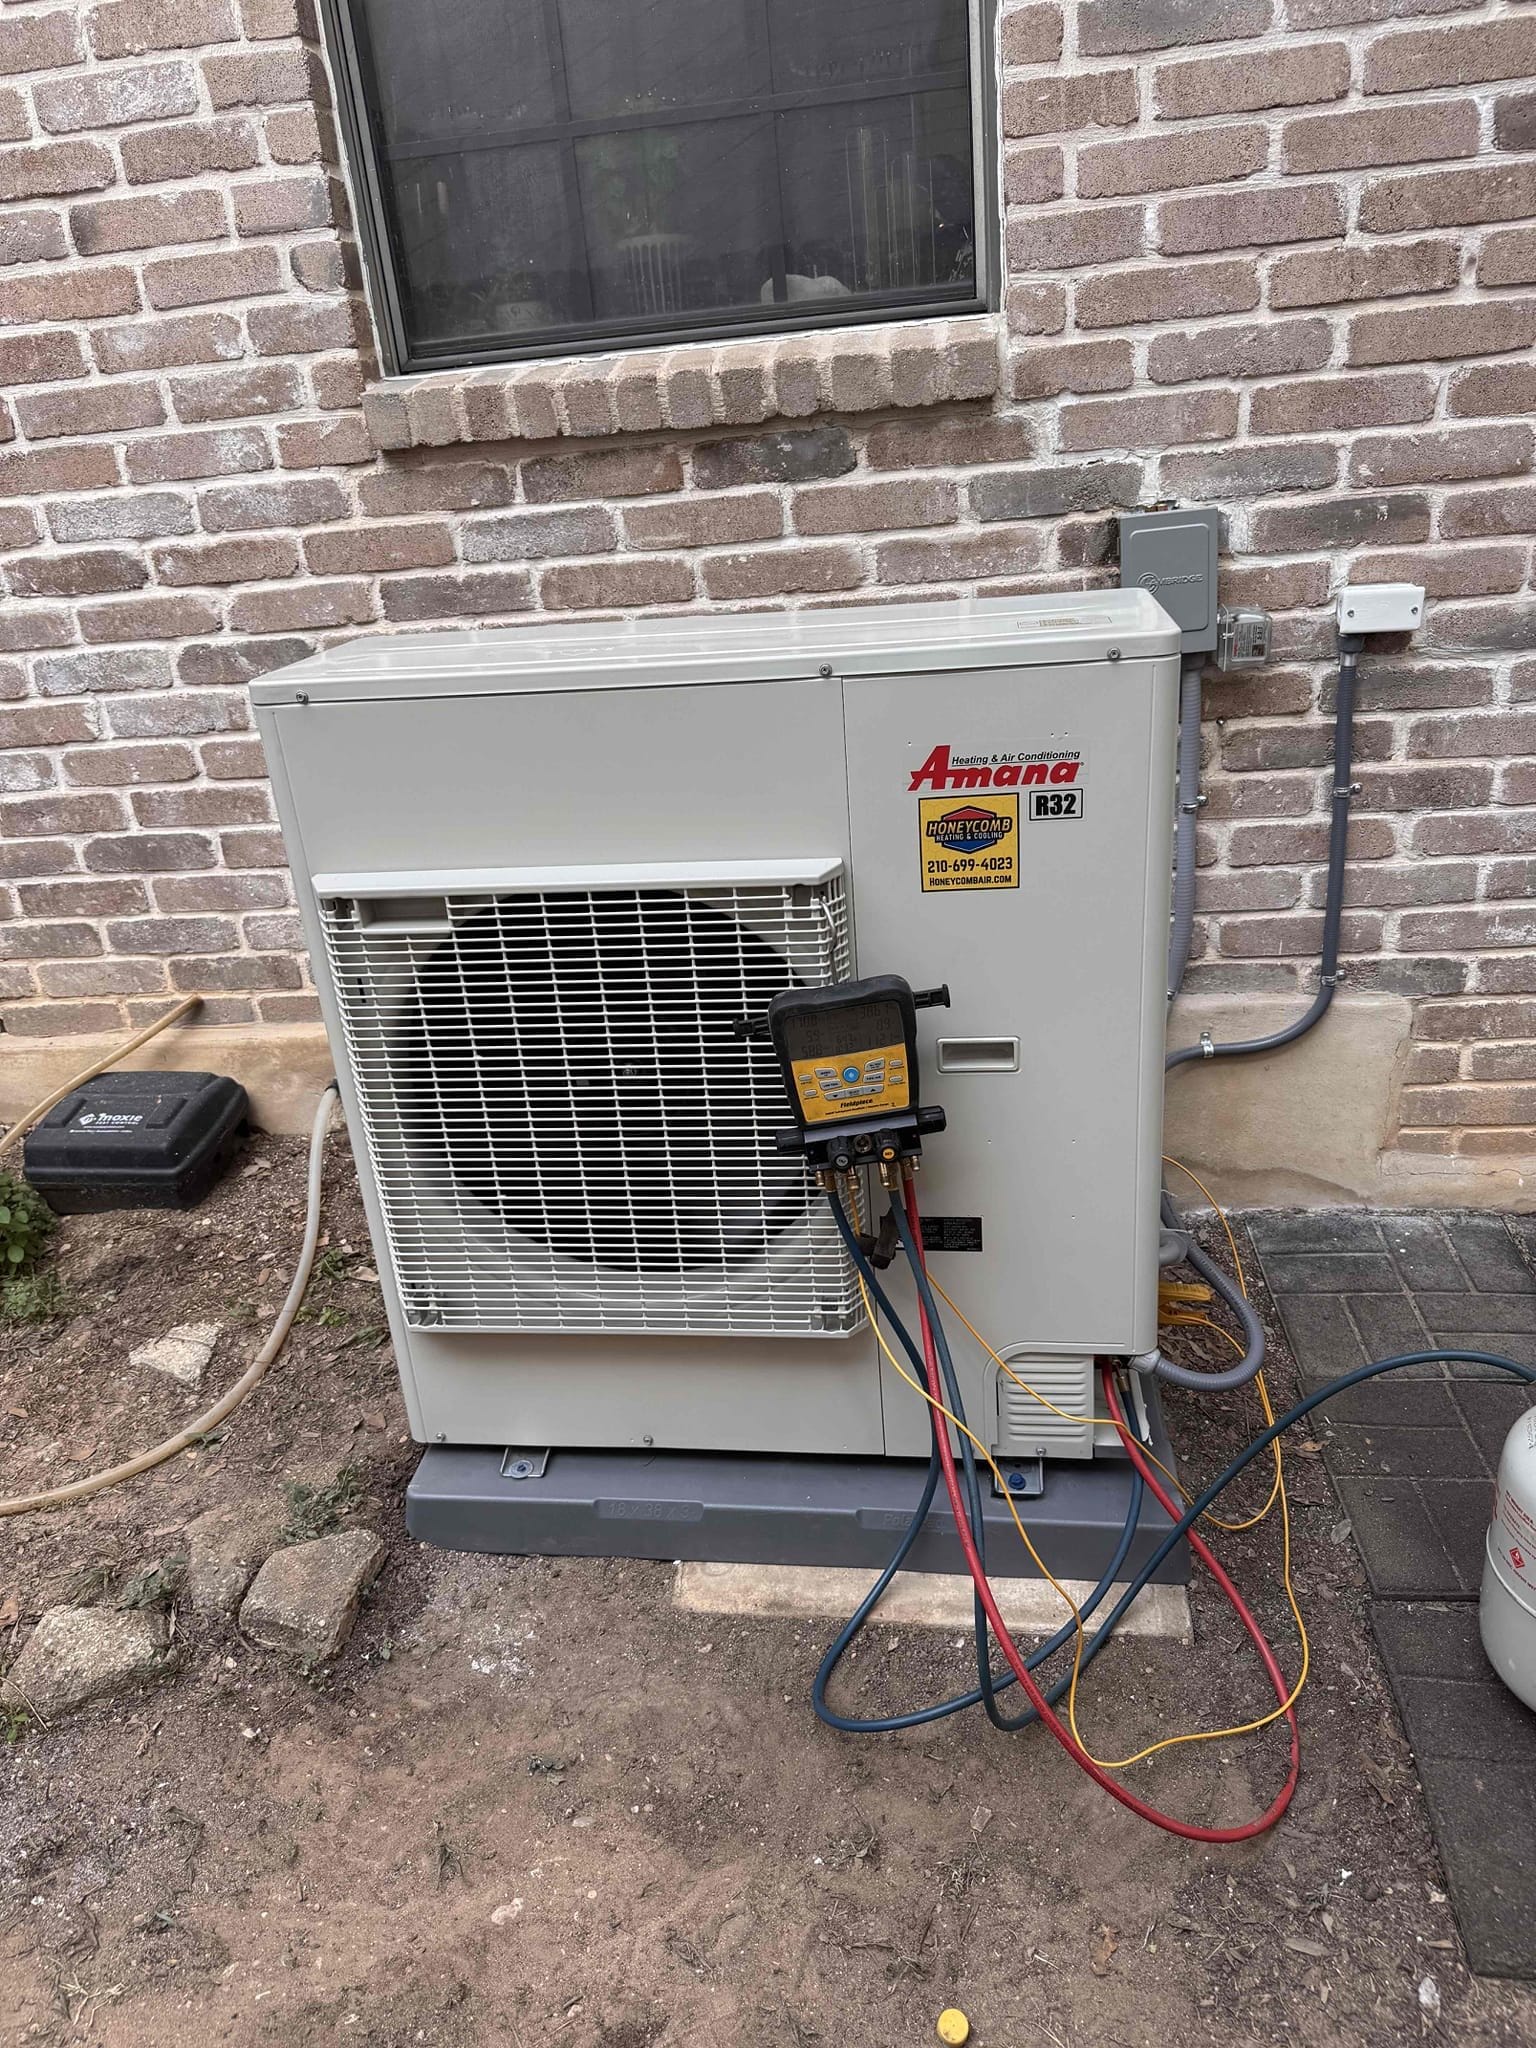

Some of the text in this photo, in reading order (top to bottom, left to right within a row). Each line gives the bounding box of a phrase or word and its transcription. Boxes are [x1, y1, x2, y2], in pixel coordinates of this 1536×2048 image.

[952, 750, 1080, 765] Heating & Air Conditioning
[907, 745, 1080, 791] Amana
[1035, 794, 1077, 816] R32
[928, 819, 1011, 835] HONEYCOMB
[936, 833, 964, 841] HEATING
[974, 831, 1003, 839] COOLING
[928, 857, 1013, 873] 210-699-4023
[929, 875, 1012, 886] HONEYCOMBAIR.COM
[840, 1099, 873, 1108] Fieldpiece
